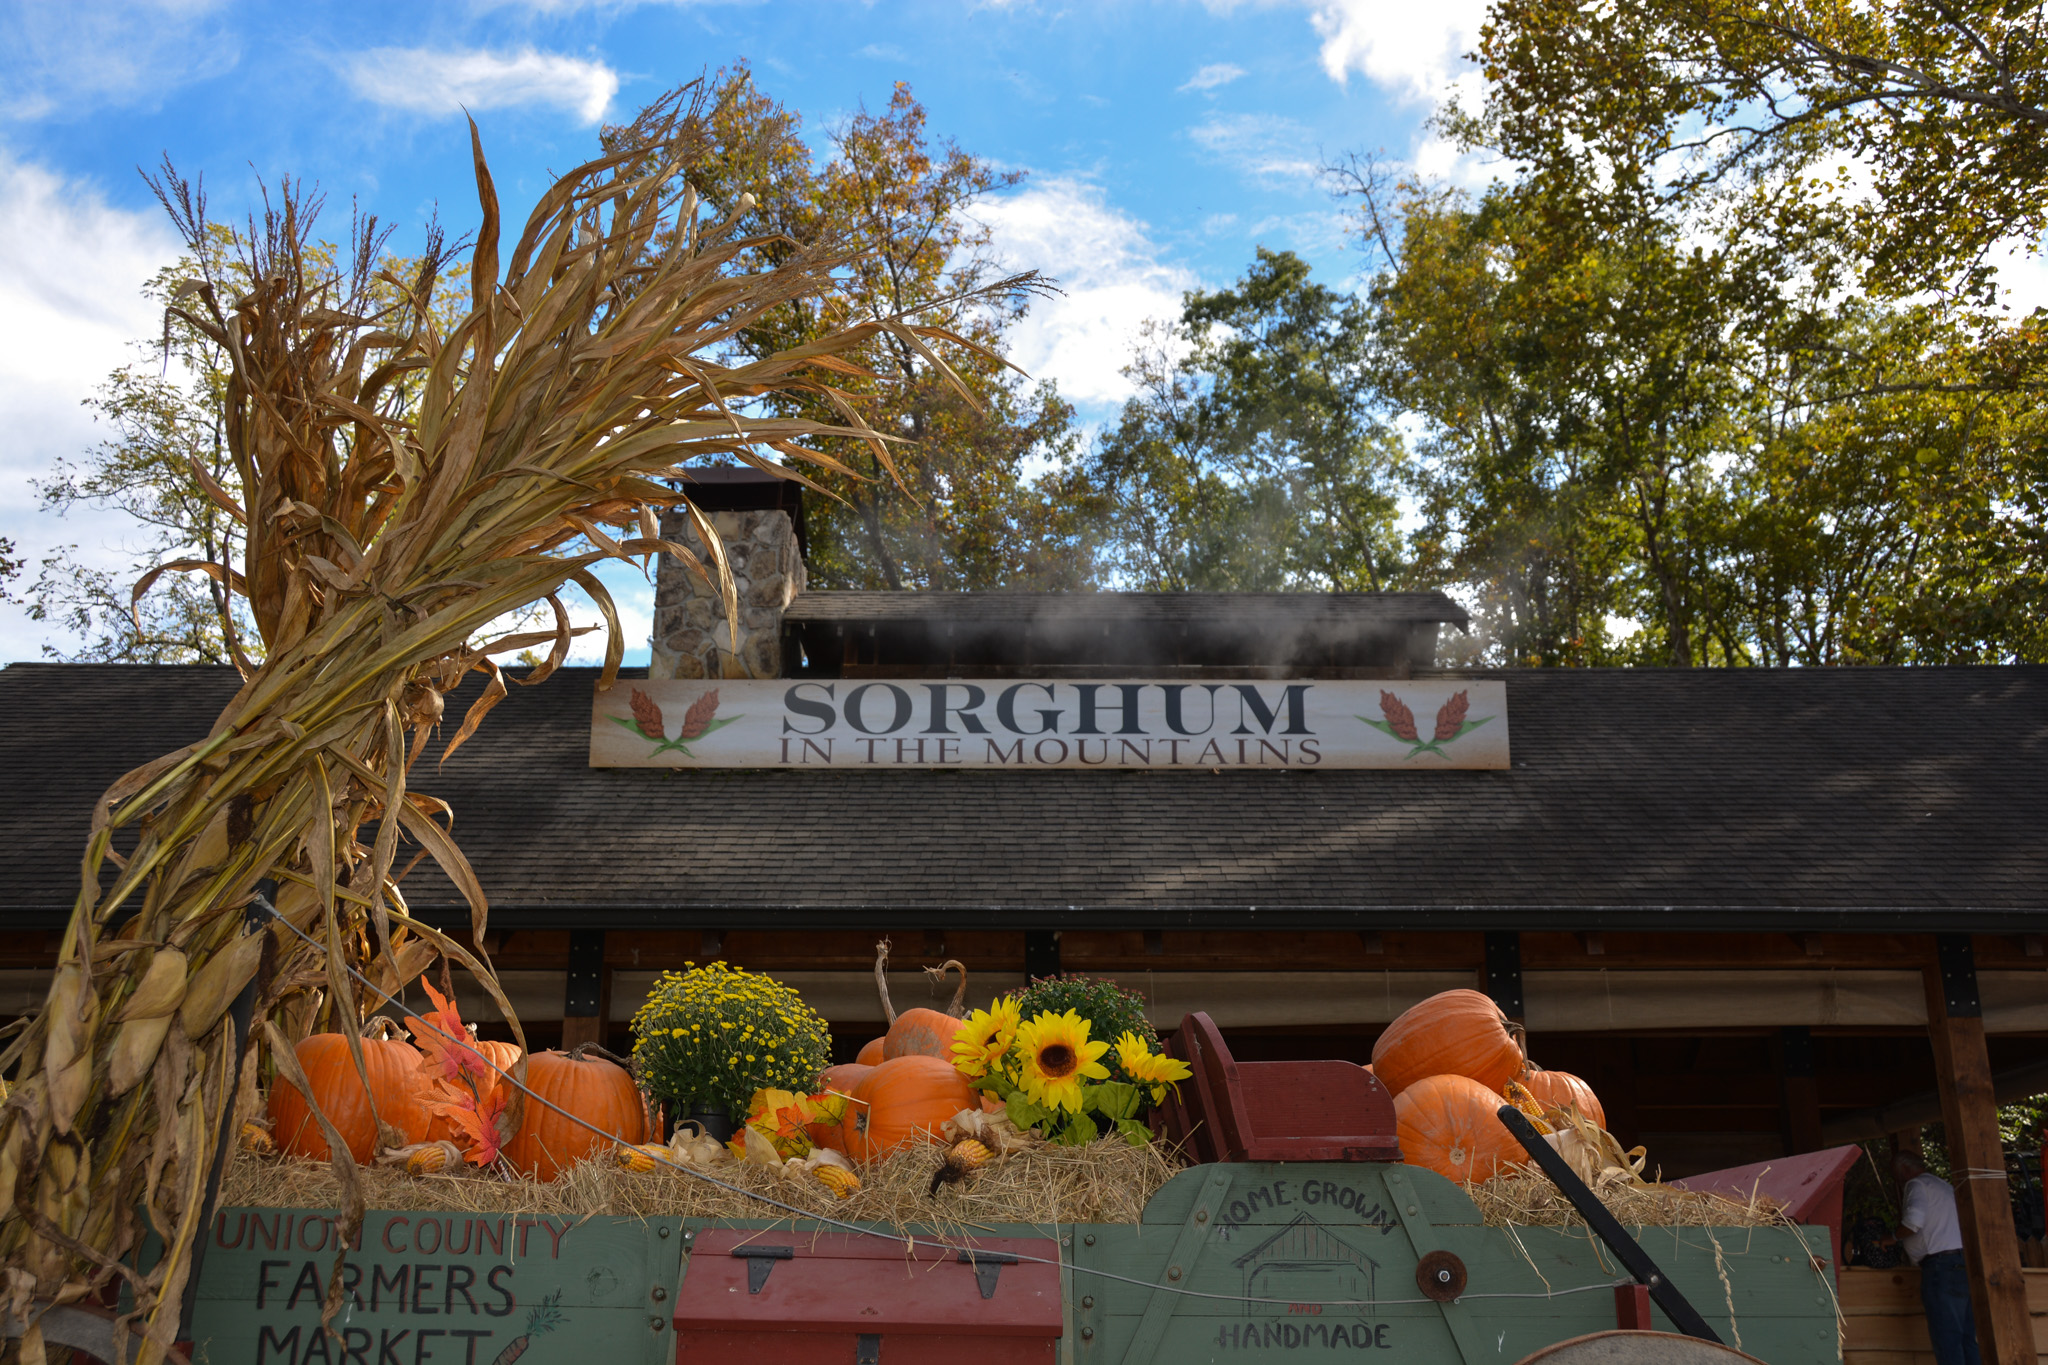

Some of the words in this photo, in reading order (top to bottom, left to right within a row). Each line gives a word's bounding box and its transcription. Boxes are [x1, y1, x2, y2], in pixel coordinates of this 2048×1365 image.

[783, 683, 1317, 735] SORGHUM
[778, 737, 836, 764] IN
[855, 737, 963, 764] THE
[983, 737, 1322, 765] MOUNTAINS
[1302, 1179, 1397, 1236] GROWN
[216, 1213, 364, 1252] UNION
[381, 1216, 573, 1260] COUNTY
[256, 1260, 516, 1317] FARMERS
[1287, 1303, 1323, 1316] AND
[256, 1325, 494, 1365] MARKET
[1219, 1323, 1392, 1349] HANDMADE
